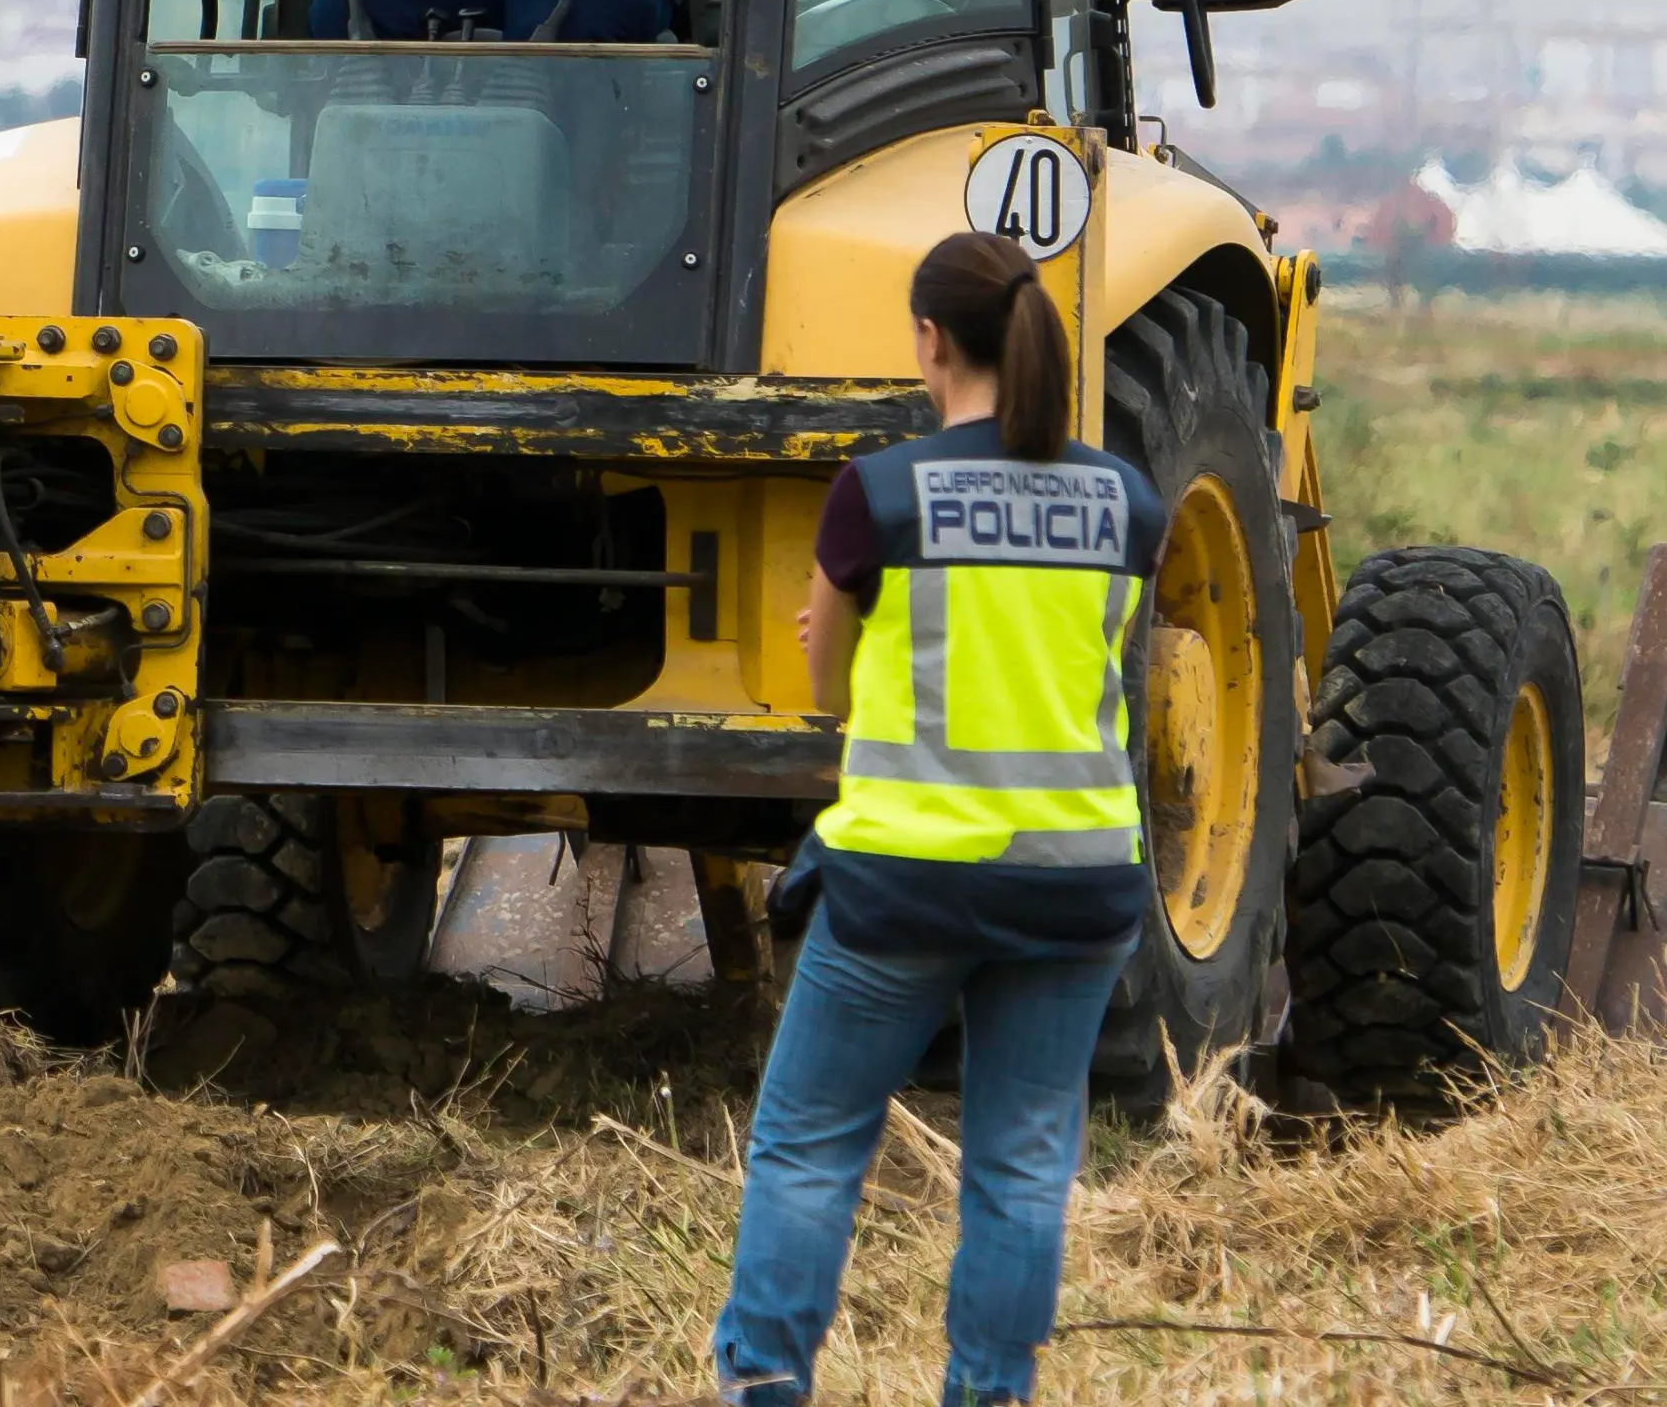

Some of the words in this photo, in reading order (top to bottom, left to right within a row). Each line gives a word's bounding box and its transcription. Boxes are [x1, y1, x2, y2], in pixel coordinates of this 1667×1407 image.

[995, 148, 1061, 247] 40
[927, 471, 1005, 494] CUERPO
[1008, 472, 1093, 499] NACIONAL
[1095, 476, 1119, 501] DE
[930, 499, 1120, 553] POLICIA
